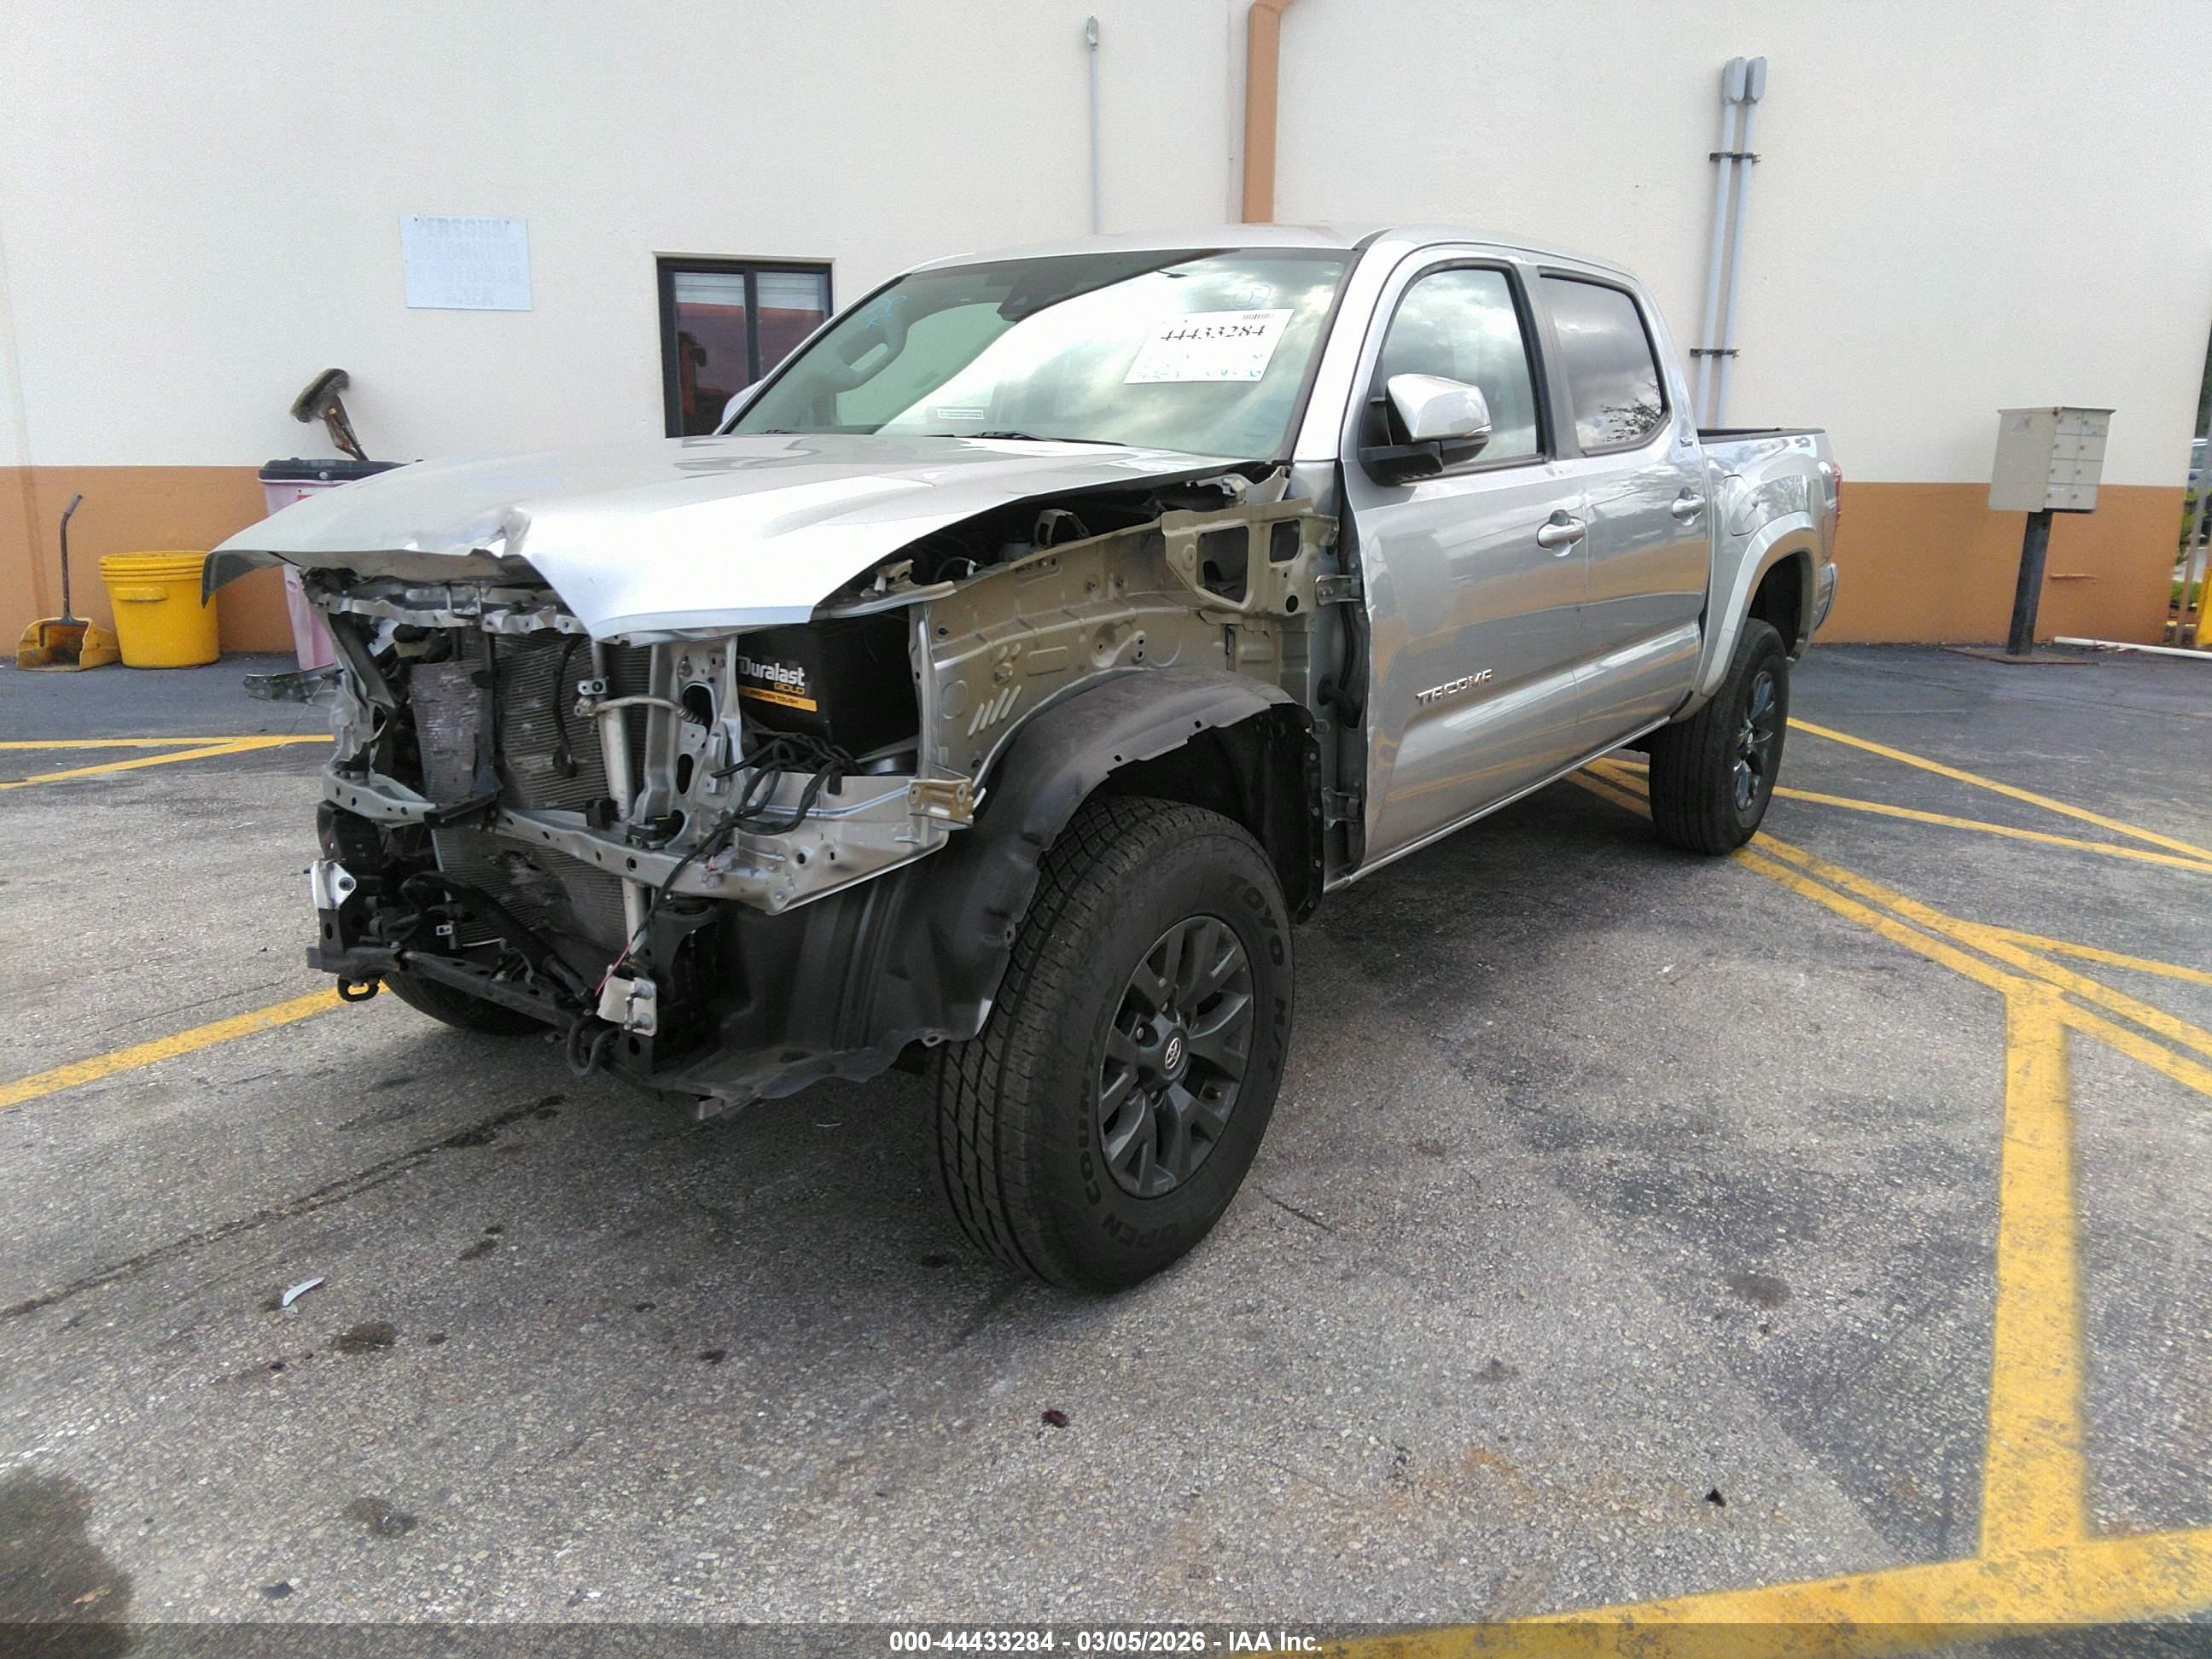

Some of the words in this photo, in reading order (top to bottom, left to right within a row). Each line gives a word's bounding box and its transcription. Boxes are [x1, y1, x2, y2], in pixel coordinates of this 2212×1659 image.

[1160, 324, 1266, 341] 44433284
[736, 655, 806, 686] Duralast
[774, 683, 806, 695] GOLD
[1226, 873, 1285, 967] TOYO
